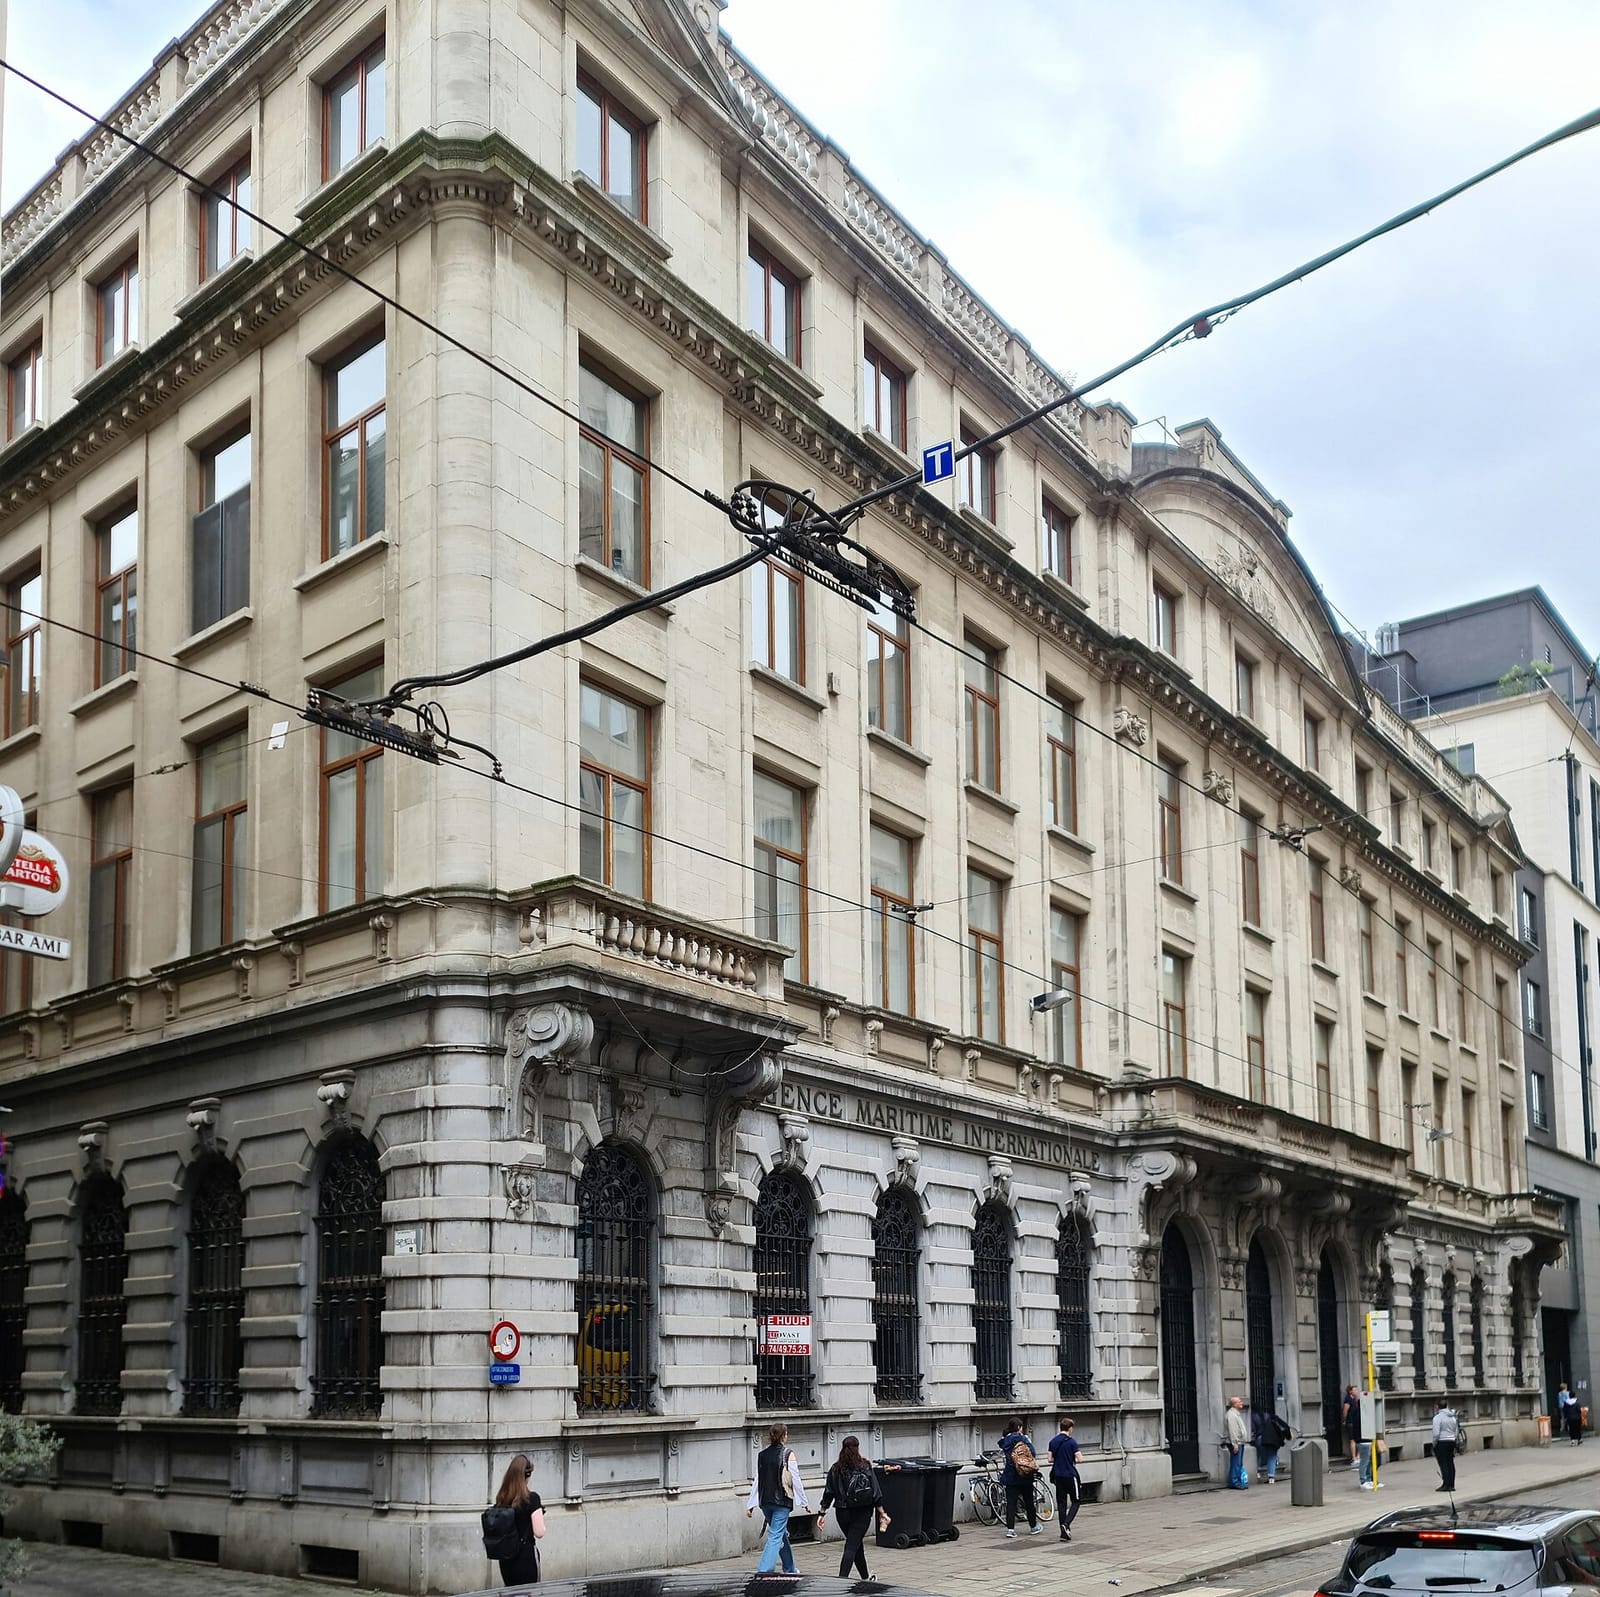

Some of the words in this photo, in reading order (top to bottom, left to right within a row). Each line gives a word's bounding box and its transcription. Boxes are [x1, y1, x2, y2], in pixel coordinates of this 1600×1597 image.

[926, 446, 949, 476] T
[11, 858, 51, 875] TELLA
[5, 867, 52, 885] ARTOIS
[30, 936, 61, 953] AMI
[856, 1099, 953, 1141] MARITIME
[964, 1122, 1100, 1171] INTERNATIONALE
[776, 1316, 808, 1325] HUUR
[760, 1344, 808, 1354] 074/49.75.25
